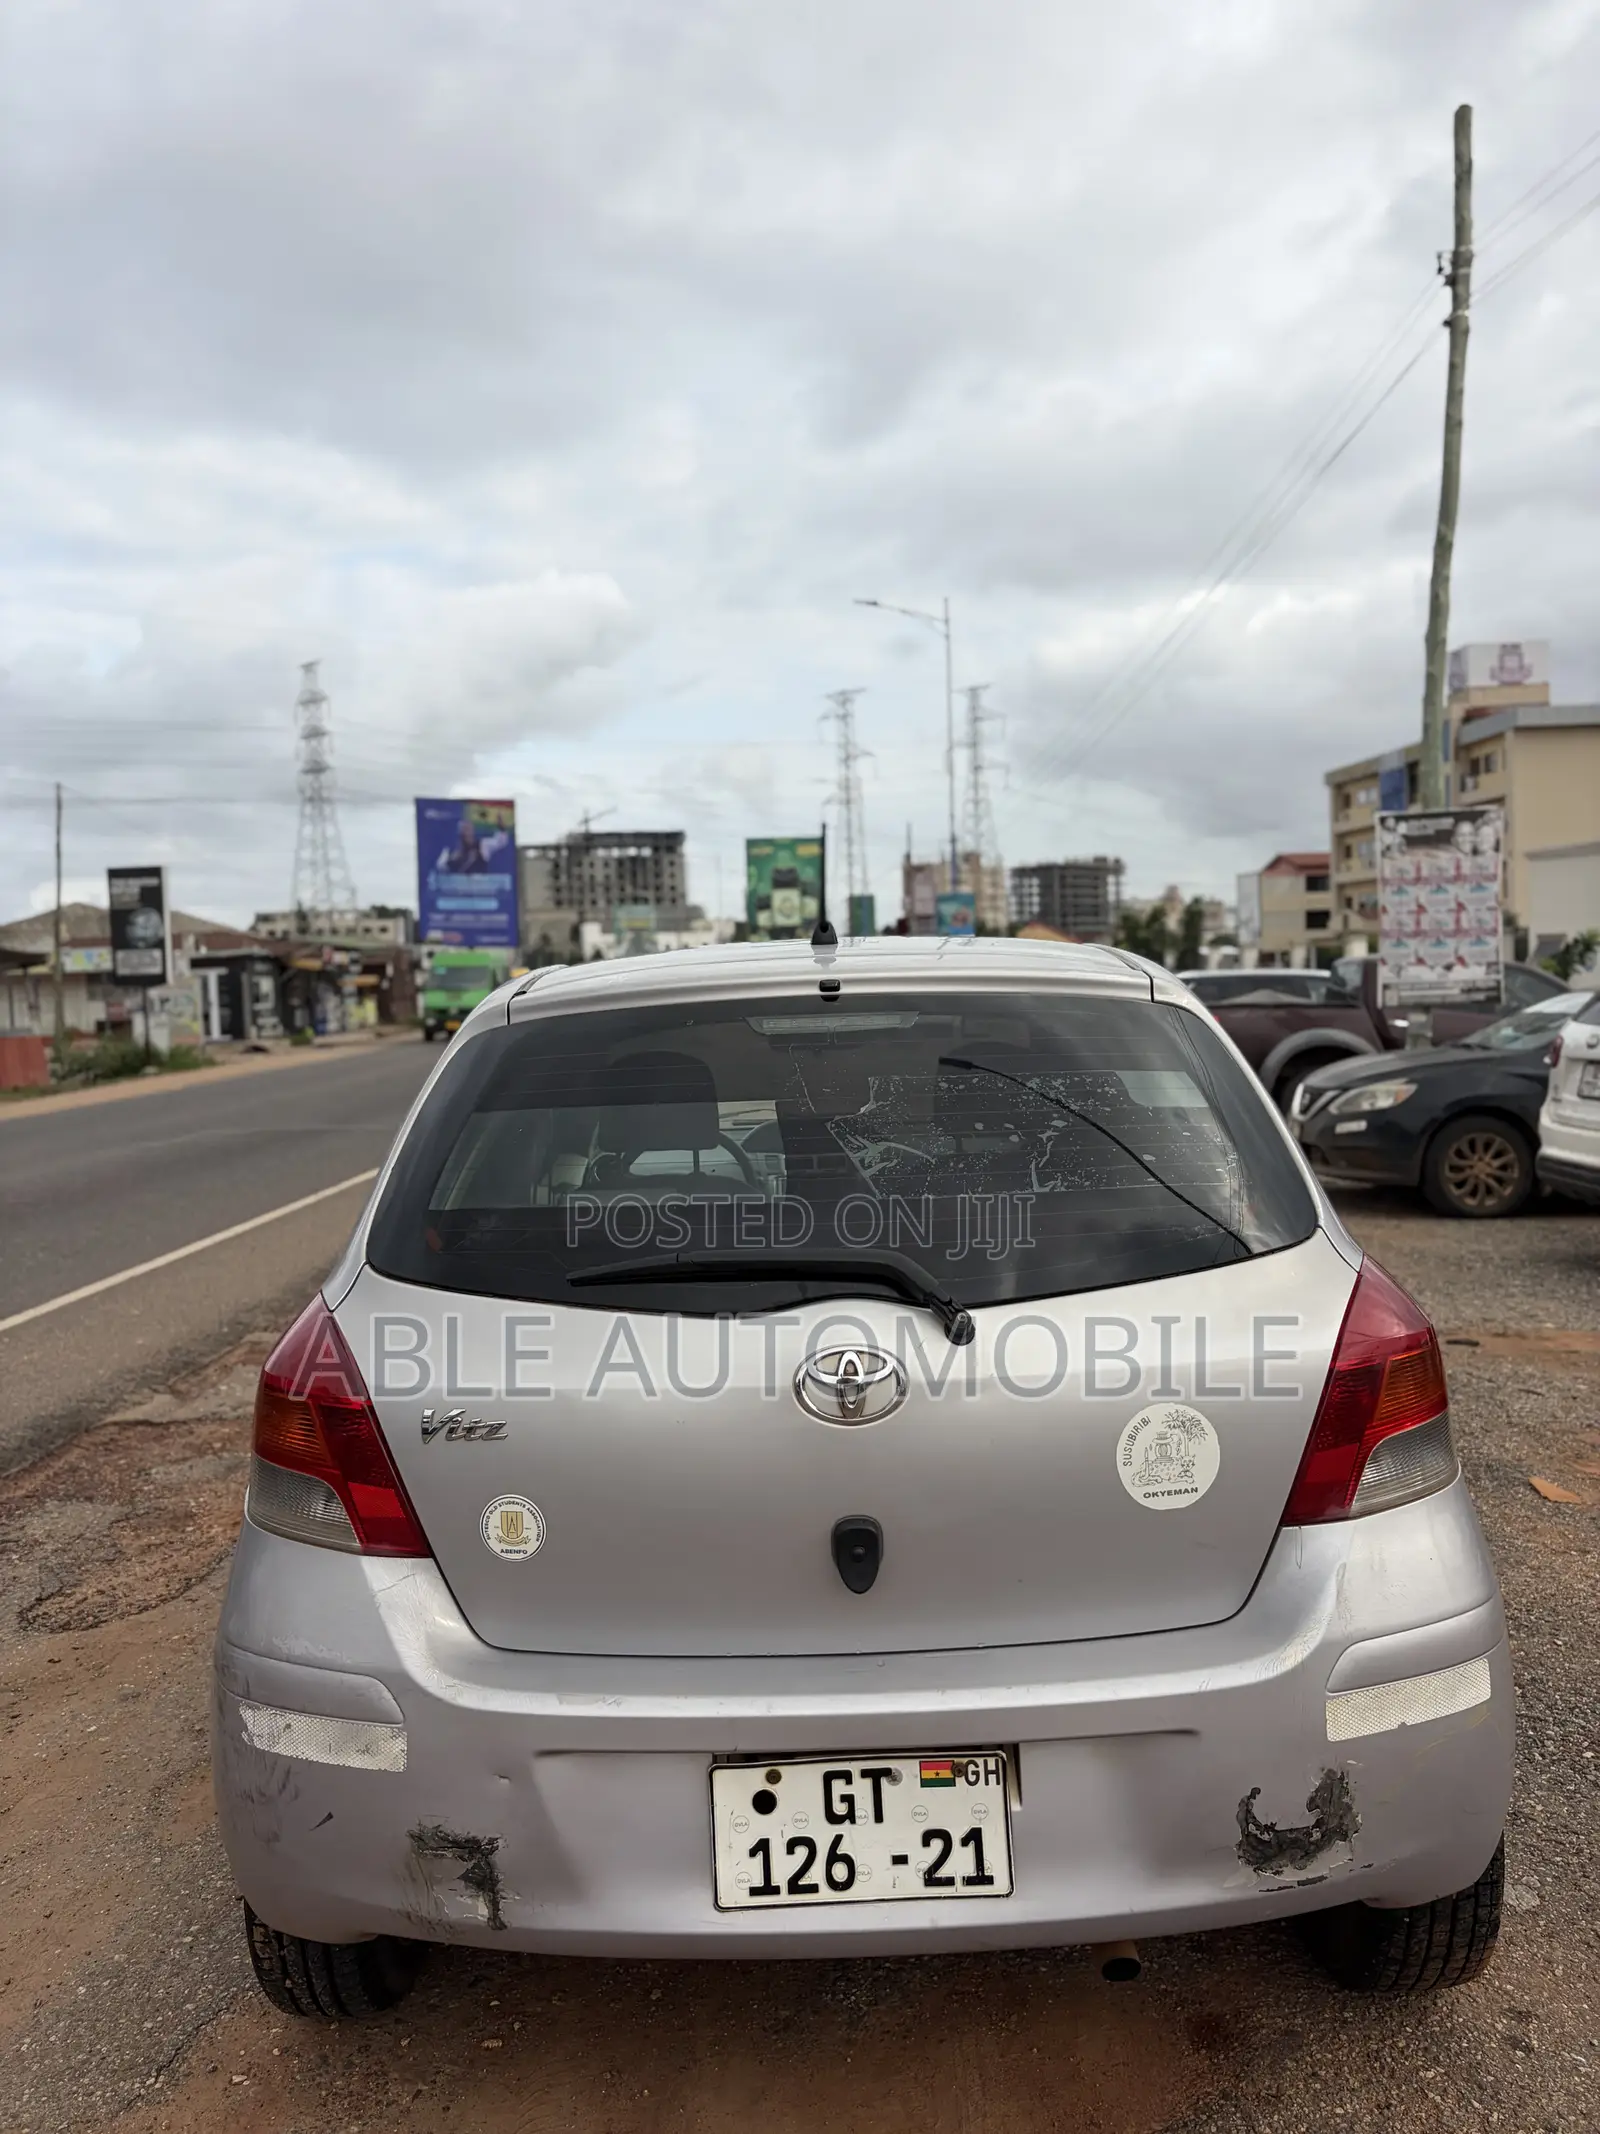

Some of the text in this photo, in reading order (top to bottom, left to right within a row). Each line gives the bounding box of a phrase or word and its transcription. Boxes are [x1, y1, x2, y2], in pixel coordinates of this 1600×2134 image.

[421, 1408, 508, 1444] Vitz
[1122, 1415, 1152, 1467] SUSUBIRIBI
[1142, 1486, 1199, 1499] OKYEMAN
[489, 1505, 498, 1515] OLD
[498, 1500, 526, 1508] STUDENTS
[526, 1507, 541, 1542] ASSOCIATION
[963, 1758, 1001, 1788] GH
[822, 1767, 893, 1825] GT
[748, 1833, 857, 1896] 126
